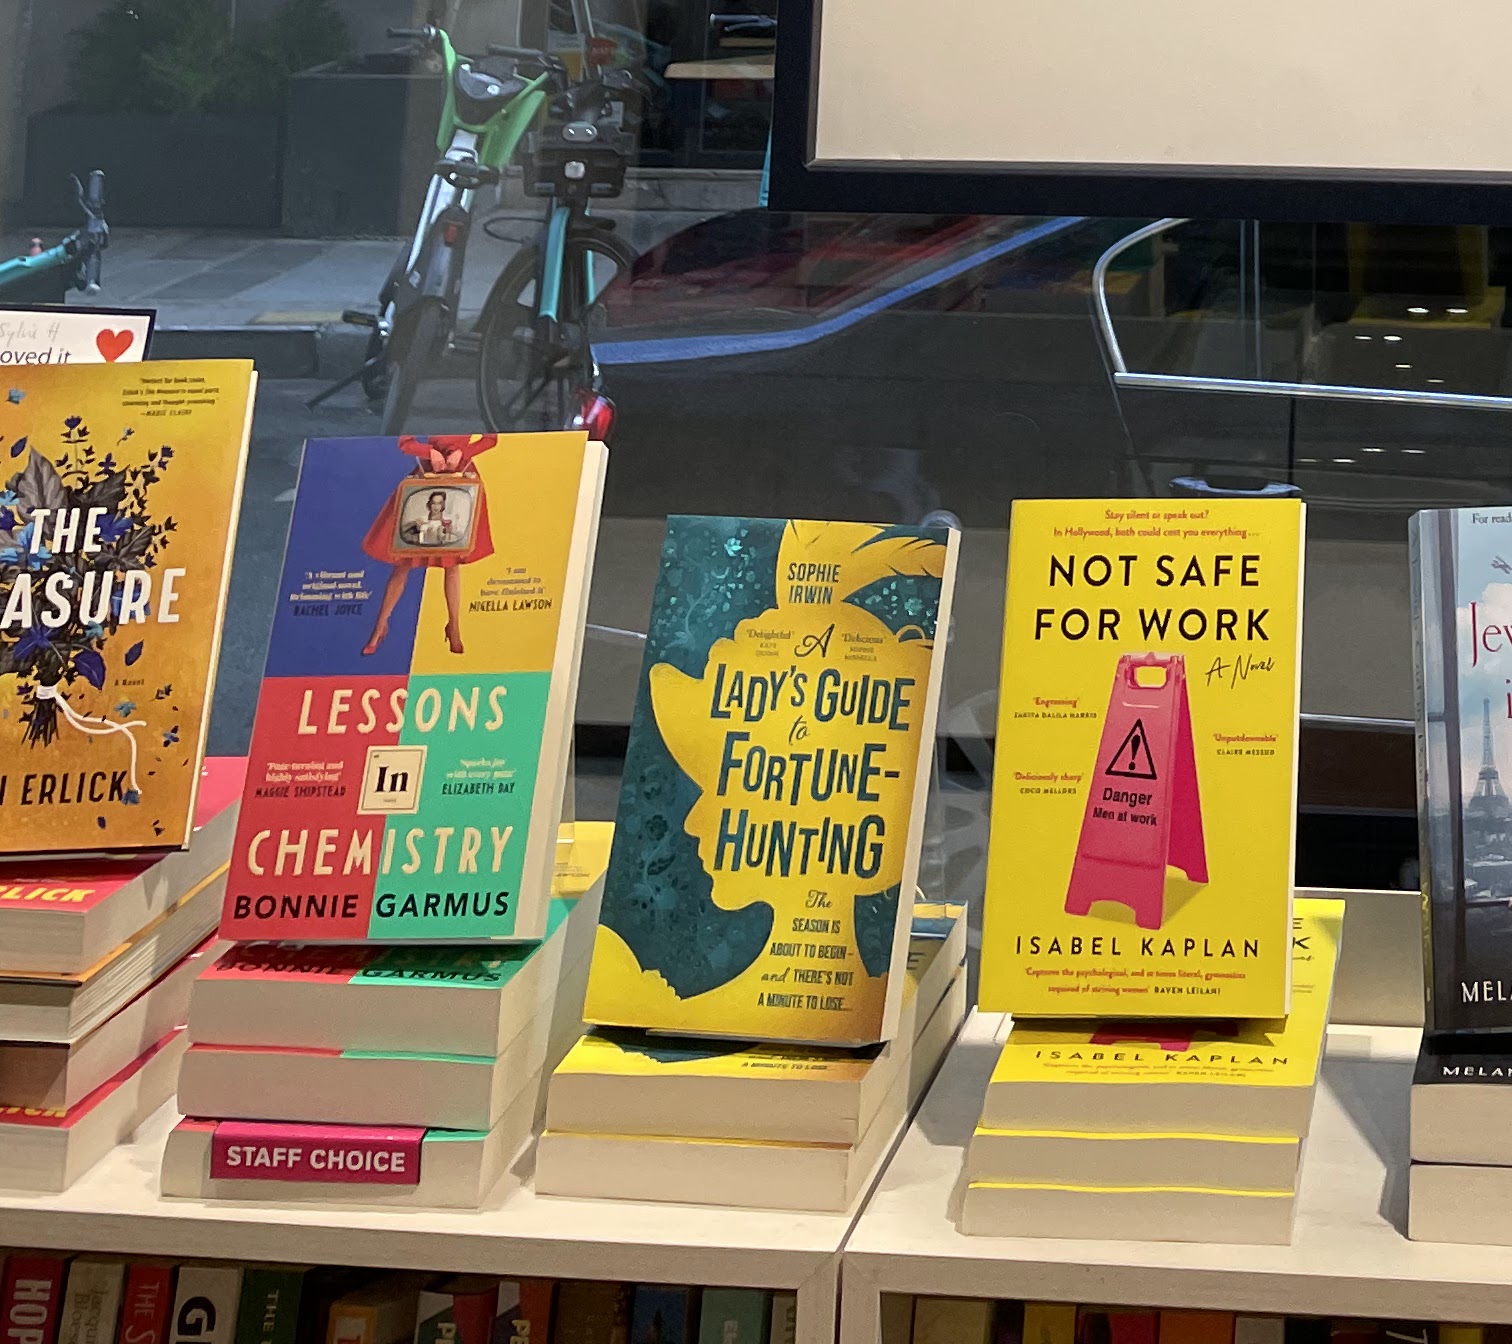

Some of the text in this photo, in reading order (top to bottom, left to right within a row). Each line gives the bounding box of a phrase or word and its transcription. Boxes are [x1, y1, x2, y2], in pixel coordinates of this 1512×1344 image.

[1105, 509, 1124, 522] Stay
[1163, 509, 1188, 523] speak
[1190, 509, 1209, 520] out?
[1472, 512, 1489, 524] For
[30, 506, 108, 555] THE
[1065, 526, 1113, 541] Hollywood,
[788, 562, 841, 584] SOPHIE
[1049, 554, 1260, 587] NOT SAFE
[0, 567, 187, 630] ASURE
[468, 598, 554, 614] NIGELLA LAWSON
[788, 584, 833, 605] IRWIN
[1034, 608, 1270, 641] FOR WORK
[794, 622, 836, 659] A
[1204, 656, 1231, 687] A
[710, 662, 916, 732] LADY'S GUIDE
[297, 684, 508, 736] LESSONS
[788, 714, 811, 747] to
[21, 770, 128, 806] ERLICK
[373, 765, 408, 793] In
[441, 782, 516, 795] ELIZABETH DAY
[1103, 787, 1153, 808] Danger
[1092, 806, 1115, 820] Men
[1130, 813, 1157, 827] work
[247, 826, 514, 877] CHEMISTRY
[712, 807, 886, 880] HUNTING
[233, 891, 510, 920] BONNIE GARMUS
[805, 889, 833, 909] The
[792, 917, 841, 934] SEASON IS
[769, 942, 817, 959] ABOUT TO
[1015, 934, 1260, 958] ISABEL KAPLAN
[362, 966, 502, 983] GARMUS
[760, 967, 855, 987] and THERE'S NOT
[757, 993, 818, 1010] A MINUTE TO
[1035, 1050, 1288, 1065] ISABEL KAPLAN
[226, 1145, 406, 1174] STAFF CHOICE
[261, 1289, 279, 1332] THE
